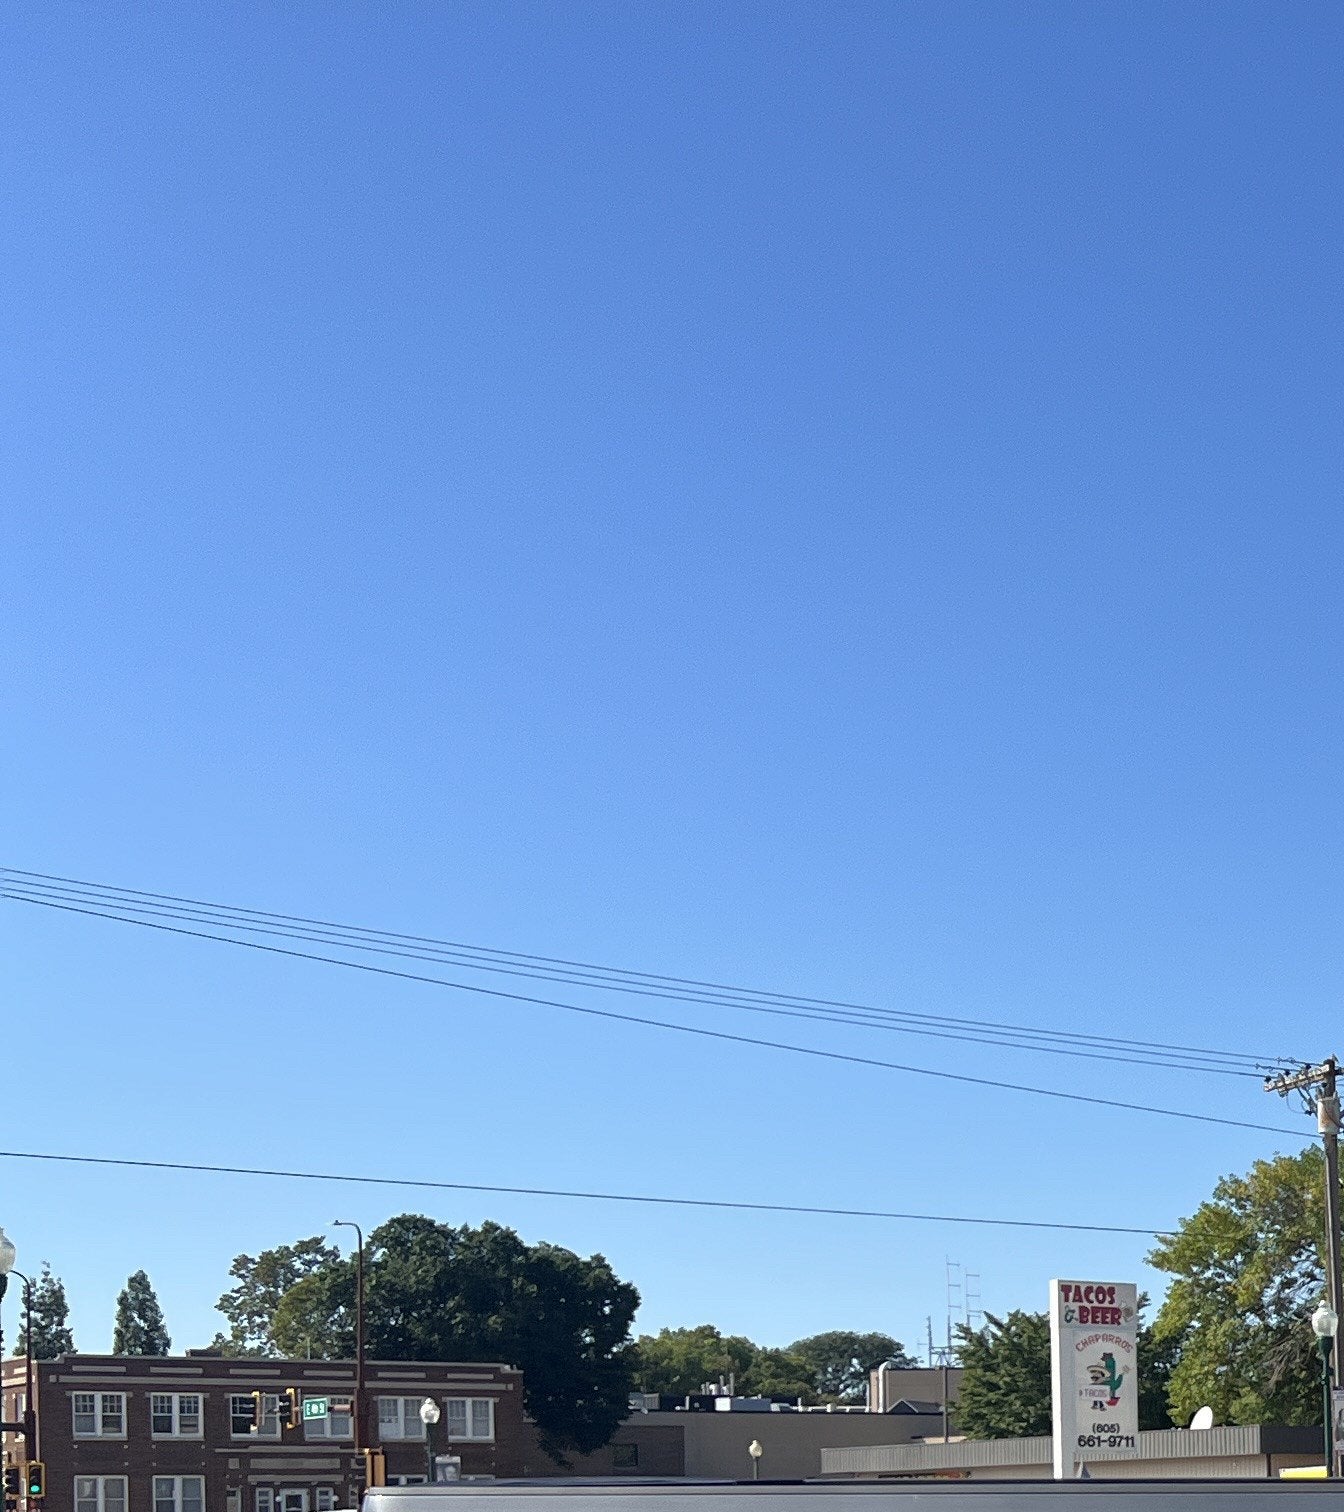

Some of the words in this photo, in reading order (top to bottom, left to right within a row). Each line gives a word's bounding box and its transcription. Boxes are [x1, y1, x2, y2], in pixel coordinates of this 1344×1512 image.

[1061, 1284, 1116, 1304] TACOS
[1079, 1305, 1123, 1326] BEER
[1076, 1333, 1134, 1354] CHAPARROS
[1092, 1423, 1120, 1434] (605)
[1077, 1435, 1135, 1448] 661-9711
